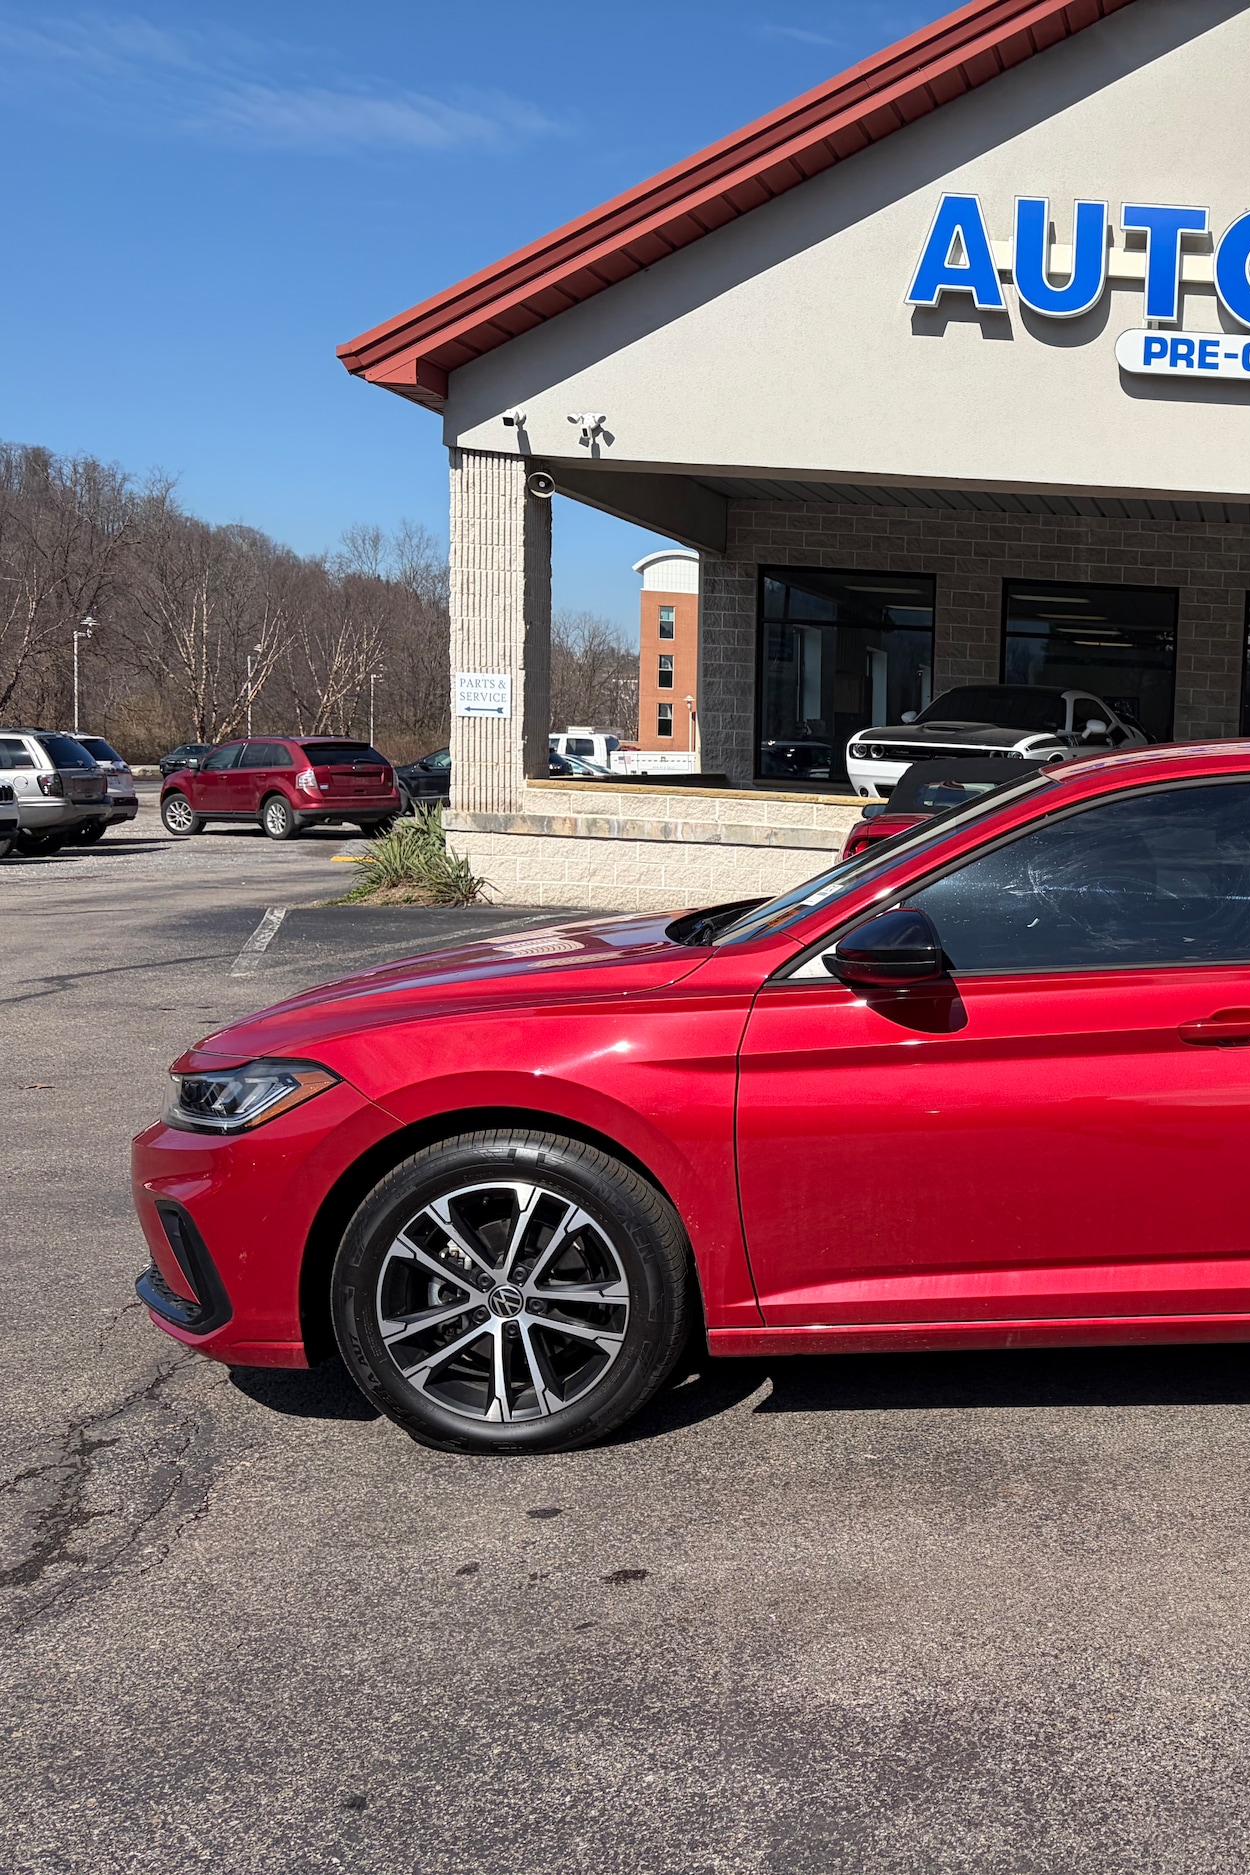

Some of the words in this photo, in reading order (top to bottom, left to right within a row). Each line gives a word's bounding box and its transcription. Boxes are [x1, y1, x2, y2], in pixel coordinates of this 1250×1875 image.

[459, 677, 496, 690] PARTS
[497, 679, 507, 690] &
[459, 691, 507, 703] SERVICE
